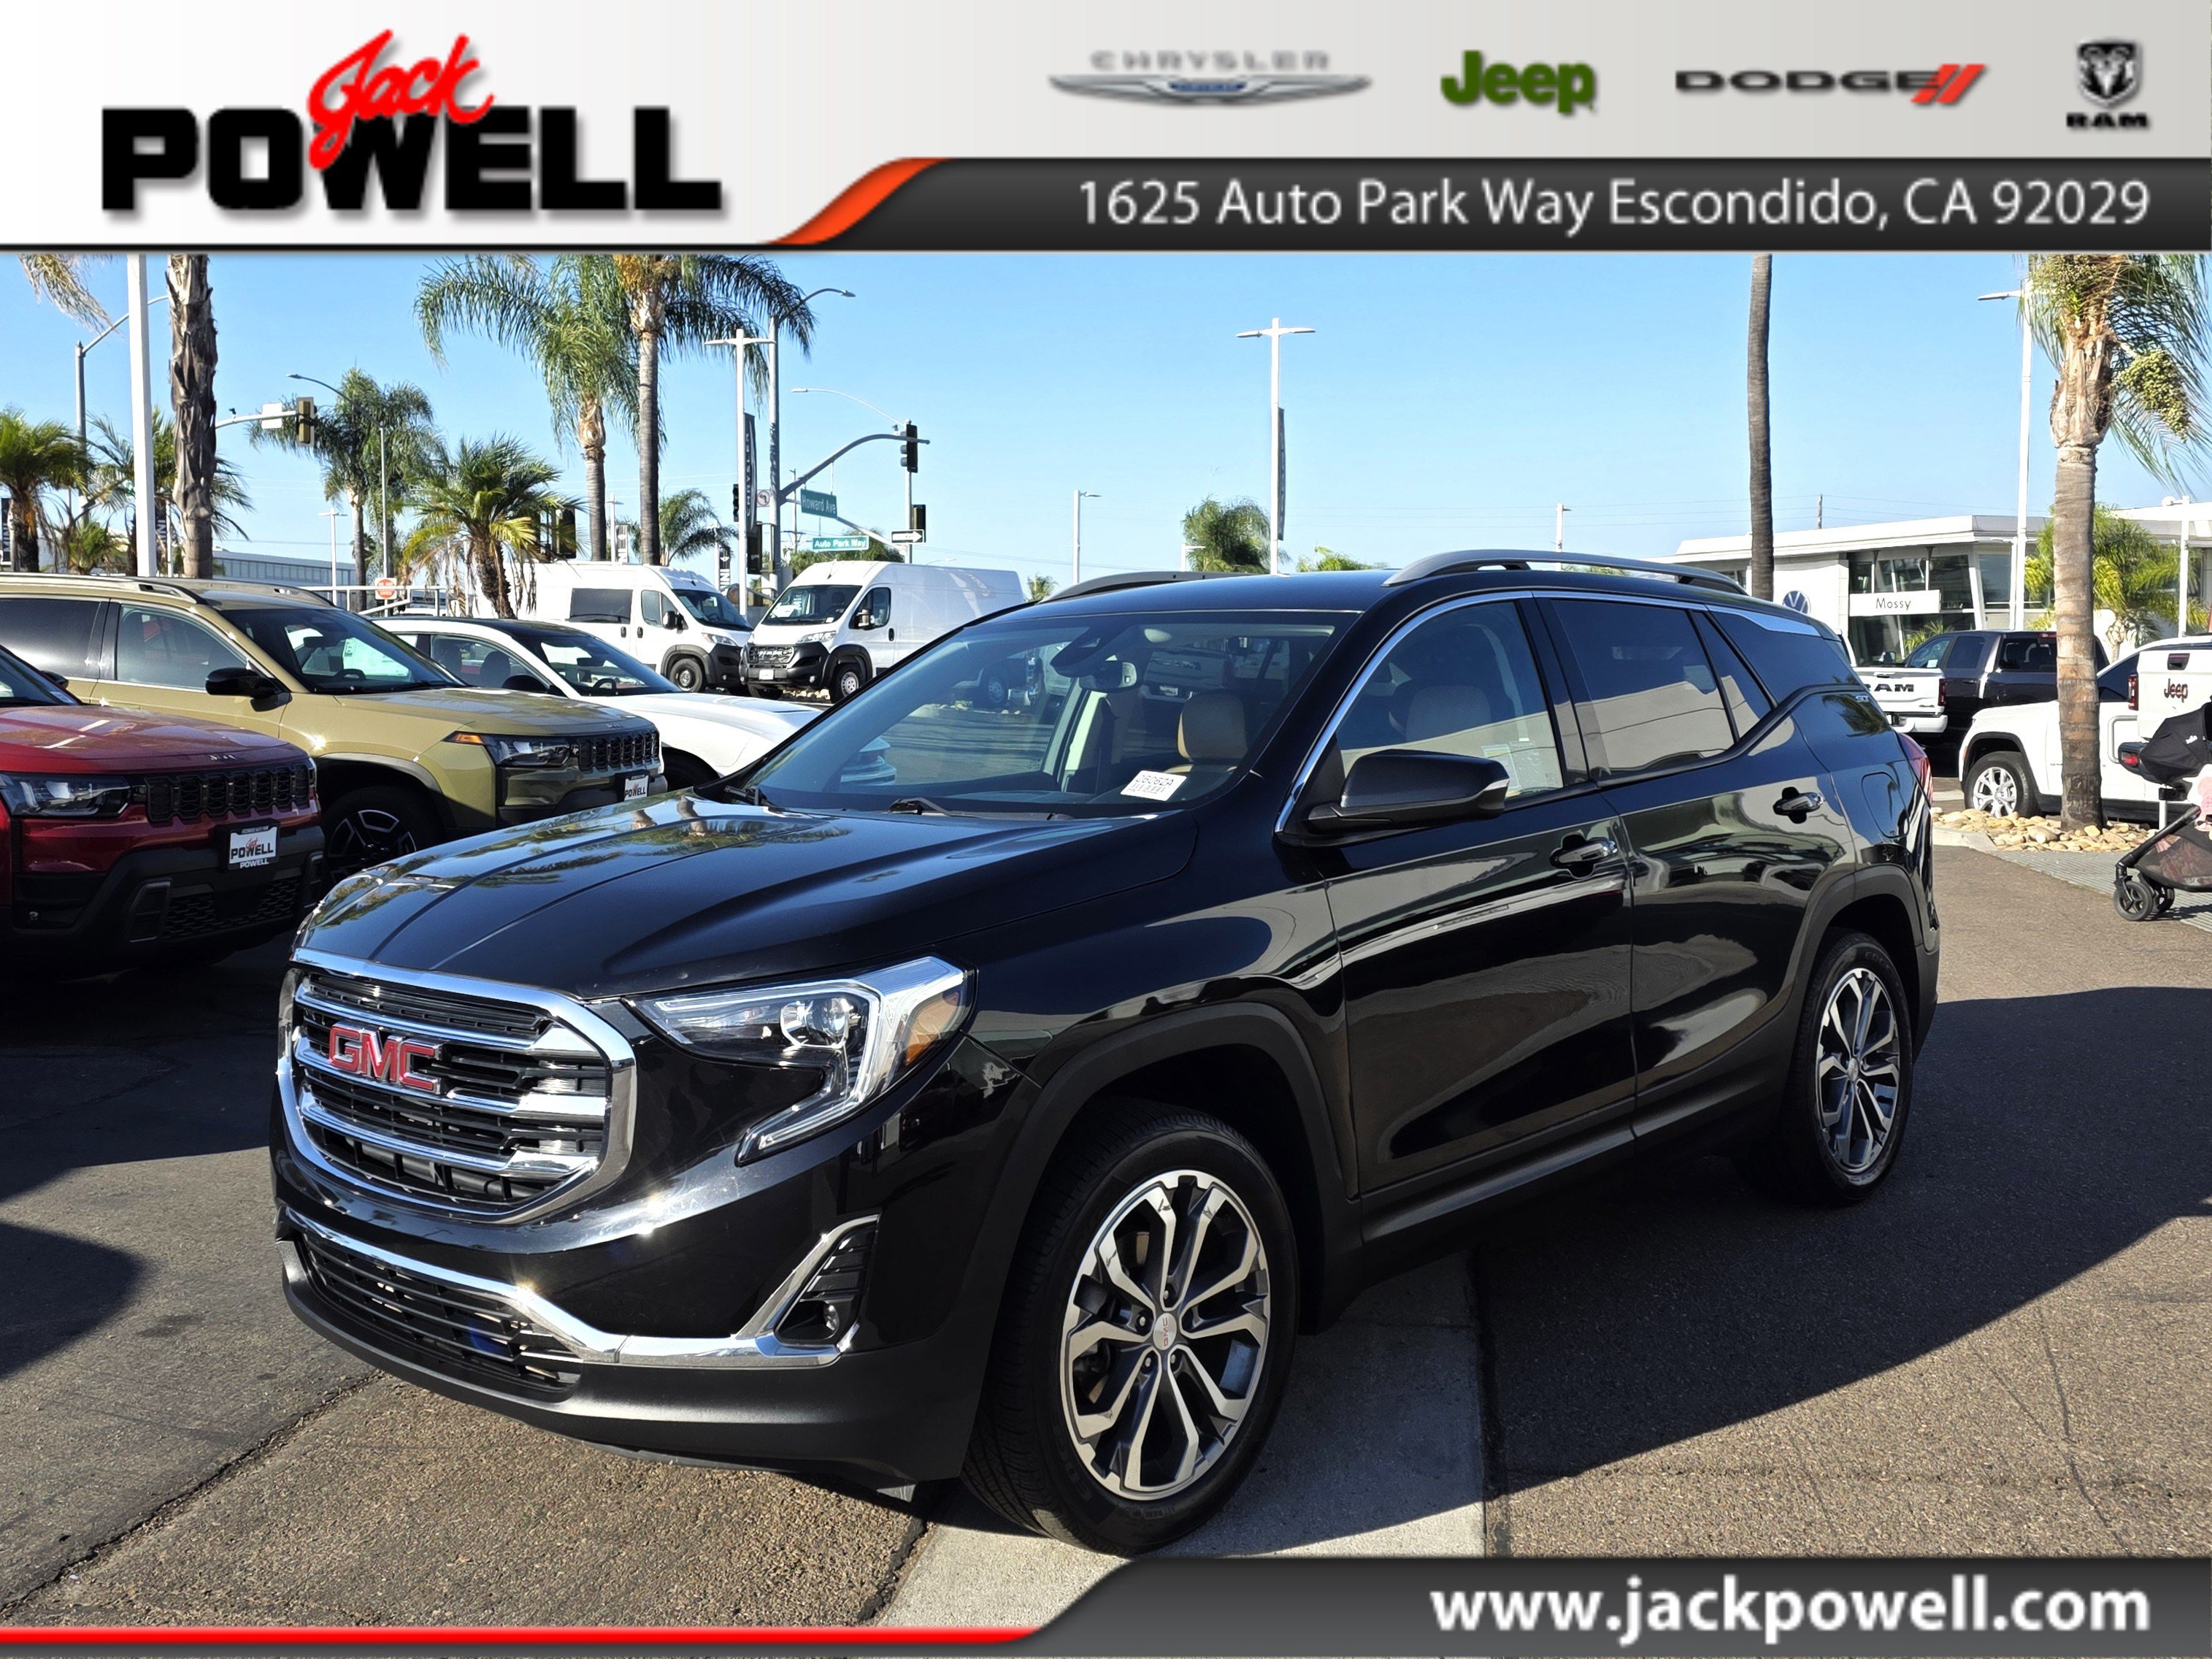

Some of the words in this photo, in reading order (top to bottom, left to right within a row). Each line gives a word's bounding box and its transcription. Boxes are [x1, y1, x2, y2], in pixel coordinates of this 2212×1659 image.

[802, 496, 825, 511] Howard
[826, 499, 836, 514] Ave
[814, 539, 831, 548] Auto
[832, 539, 850, 548] Park
[851, 539, 867, 548] Way
[1875, 597, 1911, 611] Mossy
[2163, 678, 2189, 704] Jeep
[231, 843, 274, 859] POWELL
[239, 857, 270, 870] POWELL
[329, 1022, 442, 1095] GMC
